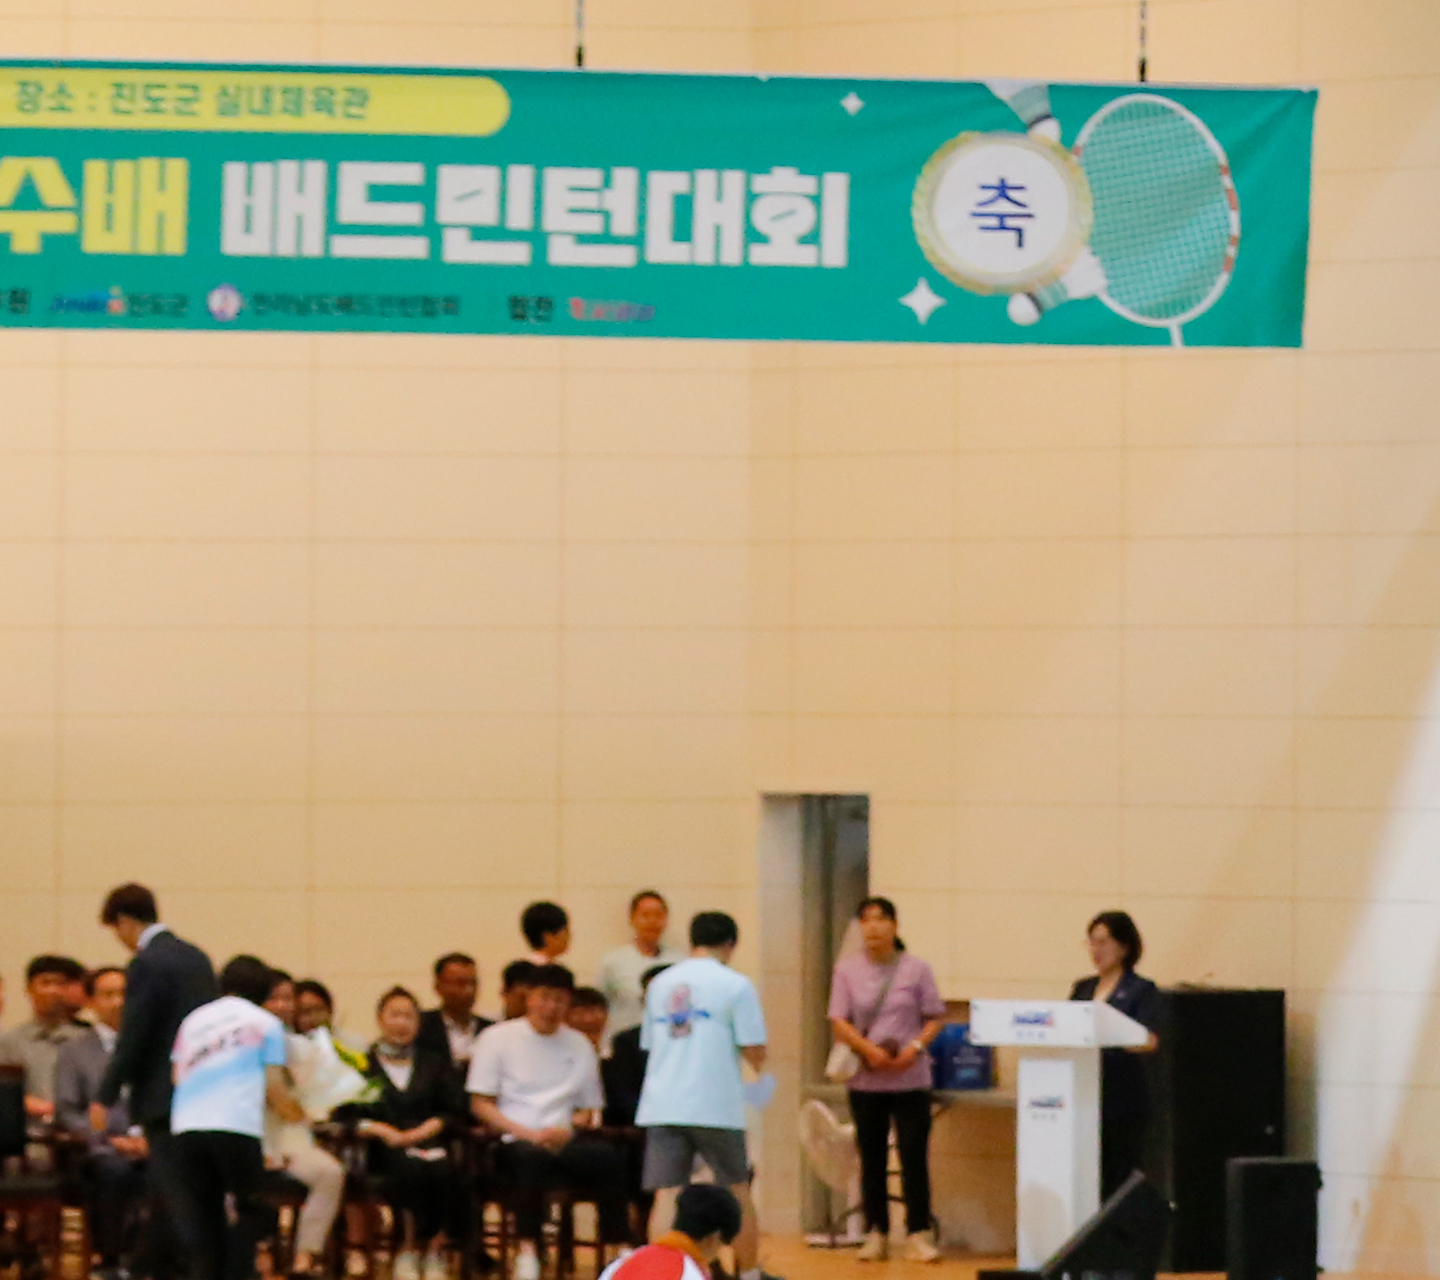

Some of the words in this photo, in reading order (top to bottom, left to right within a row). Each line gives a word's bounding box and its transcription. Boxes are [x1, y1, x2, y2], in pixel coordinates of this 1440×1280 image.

[16, 79, 74, 115] 장소
[110, 81, 201, 117] 진도군
[214, 84, 371, 119] 실내체육관
[218, 159, 850, 268] 배드민턴대회
[969, 177, 1035, 249] 축
